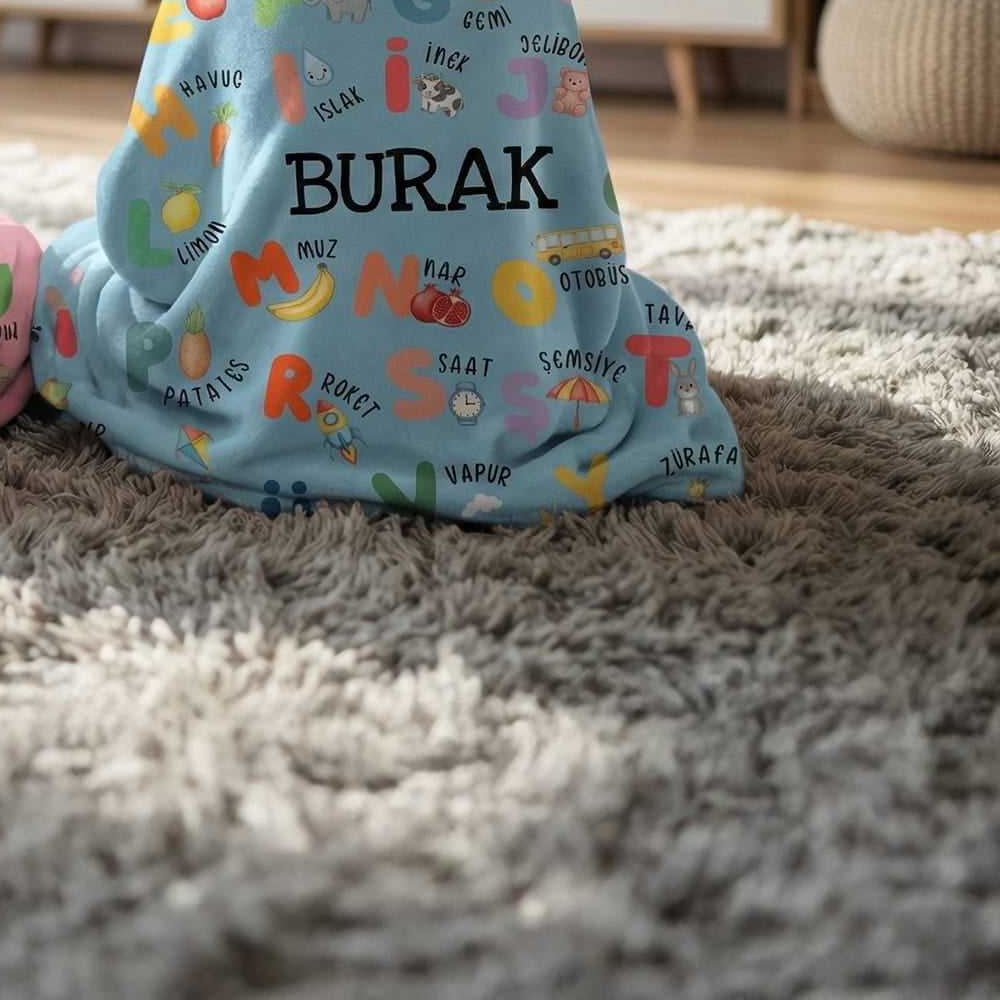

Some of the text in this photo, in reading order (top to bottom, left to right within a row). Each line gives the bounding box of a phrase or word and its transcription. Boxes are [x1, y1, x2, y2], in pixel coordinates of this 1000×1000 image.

[313, 86, 365, 122] ISLAK
[496, 57, 548, 120] J
[285, 145, 559, 216] BURAK
[128, 199, 173, 266] L
[176, 221, 226, 265] LİMON
[297, 239, 338, 260] MUZ
[230, 240, 299, 307] M
[354, 251, 420, 317] N
[424, 258, 466, 287] NAR
[491, 258, 557, 327] O
[559, 263, 630, 293] OTOBÜS
[126, 321, 173, 392] P
[438, 353, 494, 377] SAAT
[539, 349, 627, 384] ŞEMSİYE
[624, 333, 691, 408] T
[163, 359, 250, 408] PATATES
[264, 353, 312, 422] R
[320, 372, 381, 418] ROKET
[386, 347, 447, 422] S
[444, 463, 511, 487] VAPUR
[659, 445, 739, 476] ZÜRAFA
